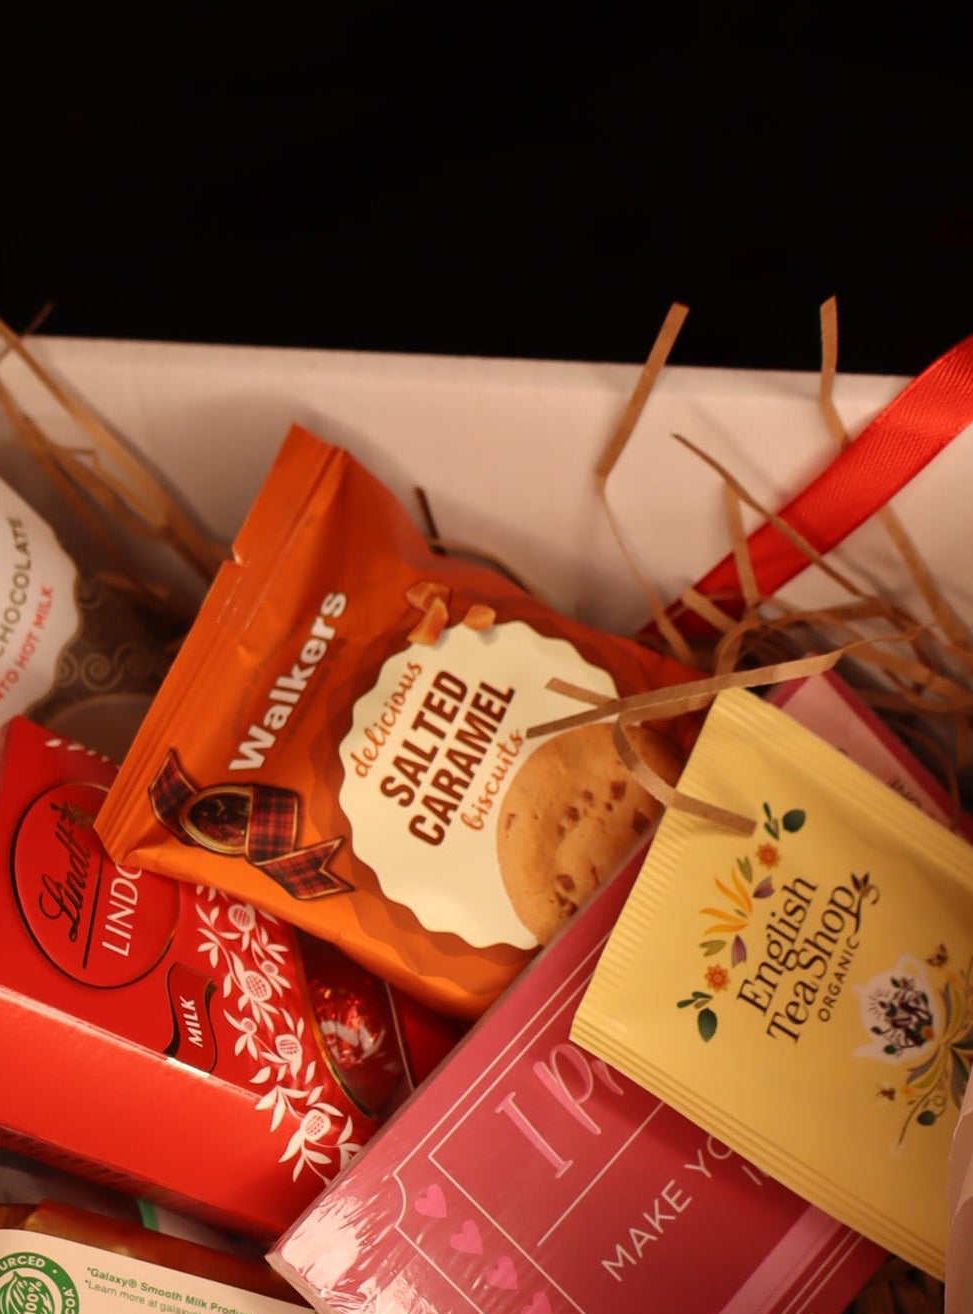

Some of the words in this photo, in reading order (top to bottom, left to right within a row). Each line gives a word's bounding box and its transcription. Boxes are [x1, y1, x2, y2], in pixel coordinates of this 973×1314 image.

[13, 631, 38, 670] HOT
[32, 585, 54, 631] MILK
[227, 591, 348, 773] Walkers
[353, 660, 423, 779] delicious
[378, 668, 469, 809] SALTED
[408, 680, 516, 848] CARAMEL
[459, 728, 527, 833] biscuits
[38, 821, 91, 943] Lindt
[736, 876, 819, 1016] English
[817, 936, 860, 1022] ORGANIC
[179, 996, 203, 1048] MILK
[600, 1179, 693, 1282] MAKE
[119, 1289, 146, 1305] more
[148, 1299, 158, 1308] at
[140, 1282, 182, 1302] Smooth
[185, 1294, 208, 1309] Milk
